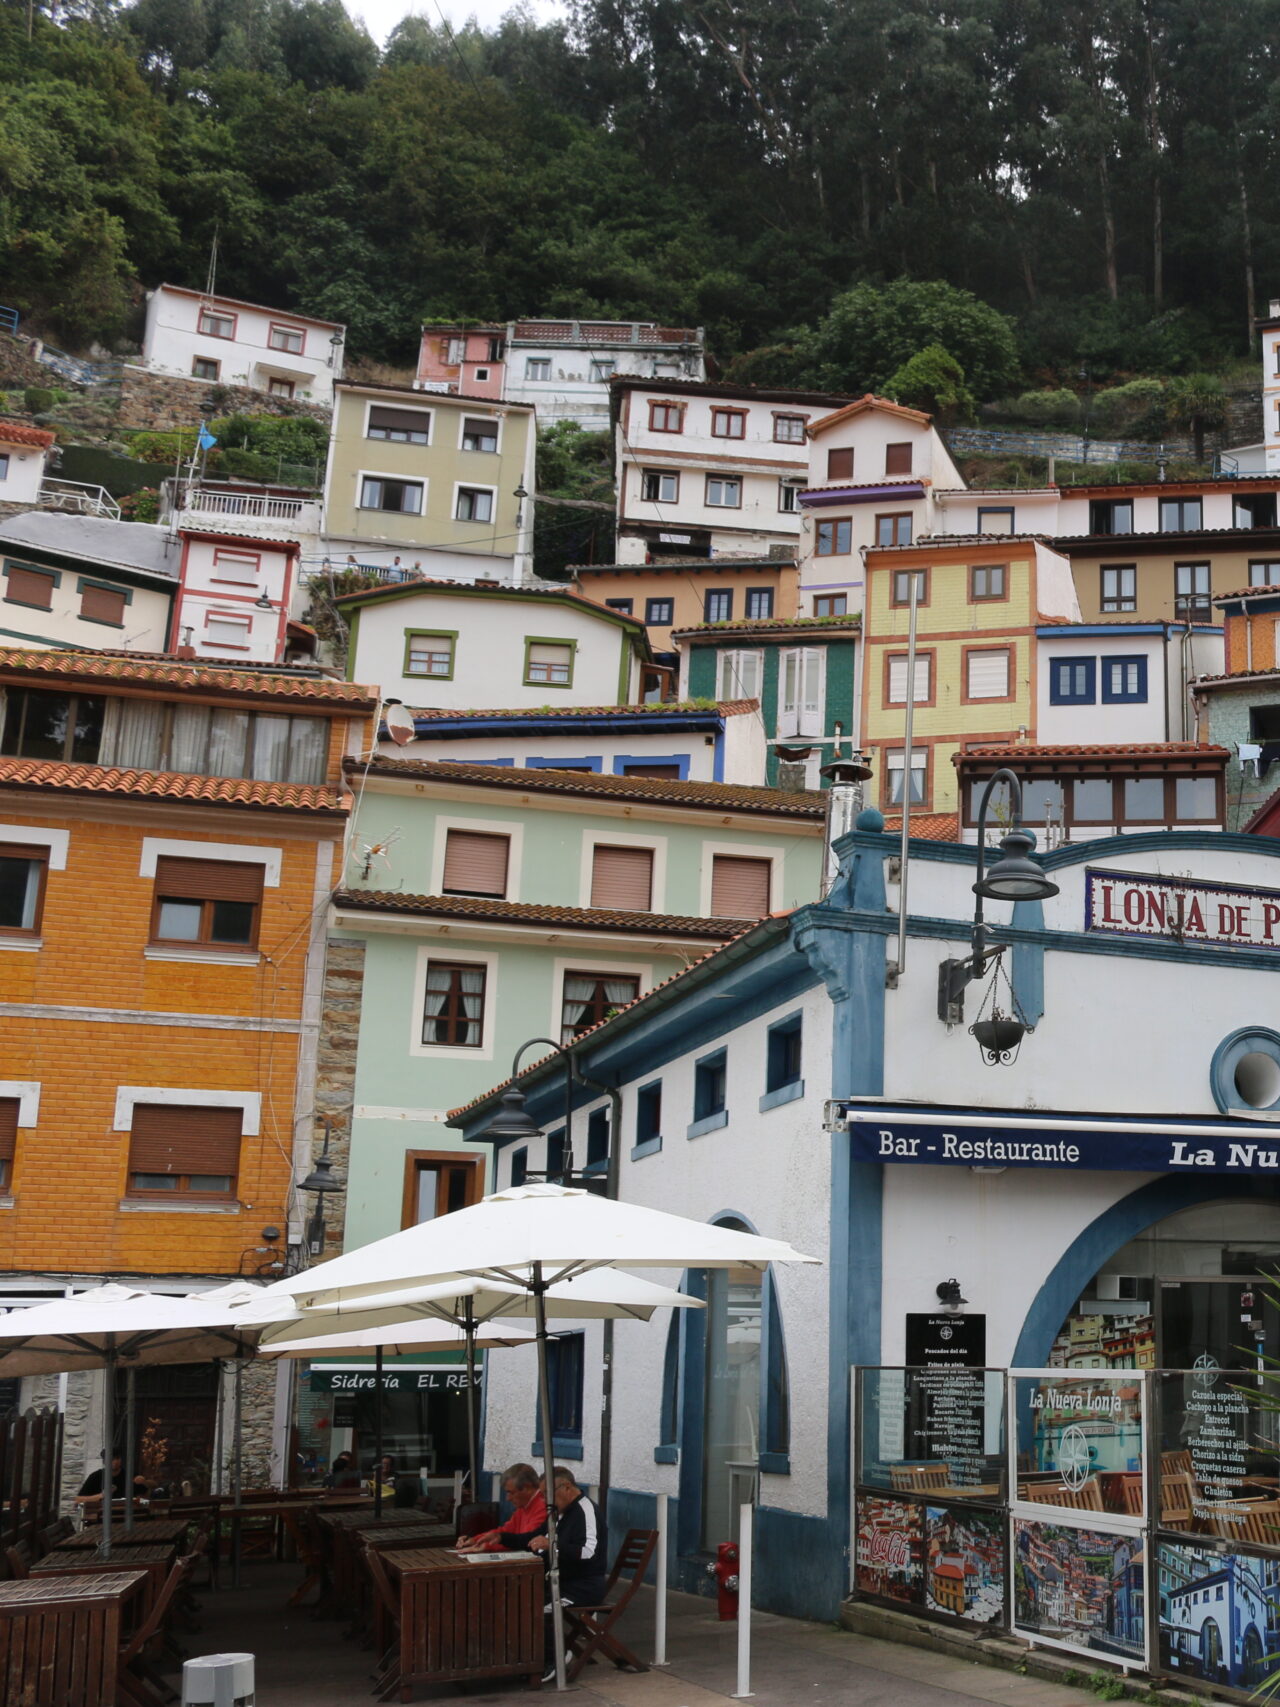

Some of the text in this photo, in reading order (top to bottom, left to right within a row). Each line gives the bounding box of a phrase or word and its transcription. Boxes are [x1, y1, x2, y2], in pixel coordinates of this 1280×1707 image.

[1101, 885, 1206, 934] LONJA
[1218, 904, 1250, 936] DE
[878, 1130, 920, 1157] Bar
[942, 1133, 1080, 1162] Restaurante
[1168, 1141, 1216, 1167] La
[417, 1374, 440, 1388] EL
[1029, 1387, 1122, 1417] La Nueva Lonja
[1192, 1390, 1243, 1402] Cazuela especial
[1186, 1401, 1211, 1413] Cachopo
[1218, 1403, 1224, 1412] la
[1225, 1403, 1249, 1414] plancha
[1205, 1414, 1230, 1425] Entrecot
[1188, 1436, 1249, 1451] Berberechos al ajillo
[1192, 1448, 1215, 1459] Chorizo
[1222, 1450, 1228, 1460] la
[1229, 1451, 1245, 1462] sidra
[1191, 1460, 1246, 1474] Croquetas caseras
[1195, 1472, 1243, 1487] Tabla de quesos
[1204, 1485, 1233, 1497] Chuletón
[1193, 1508, 1210, 1520] Oreja
